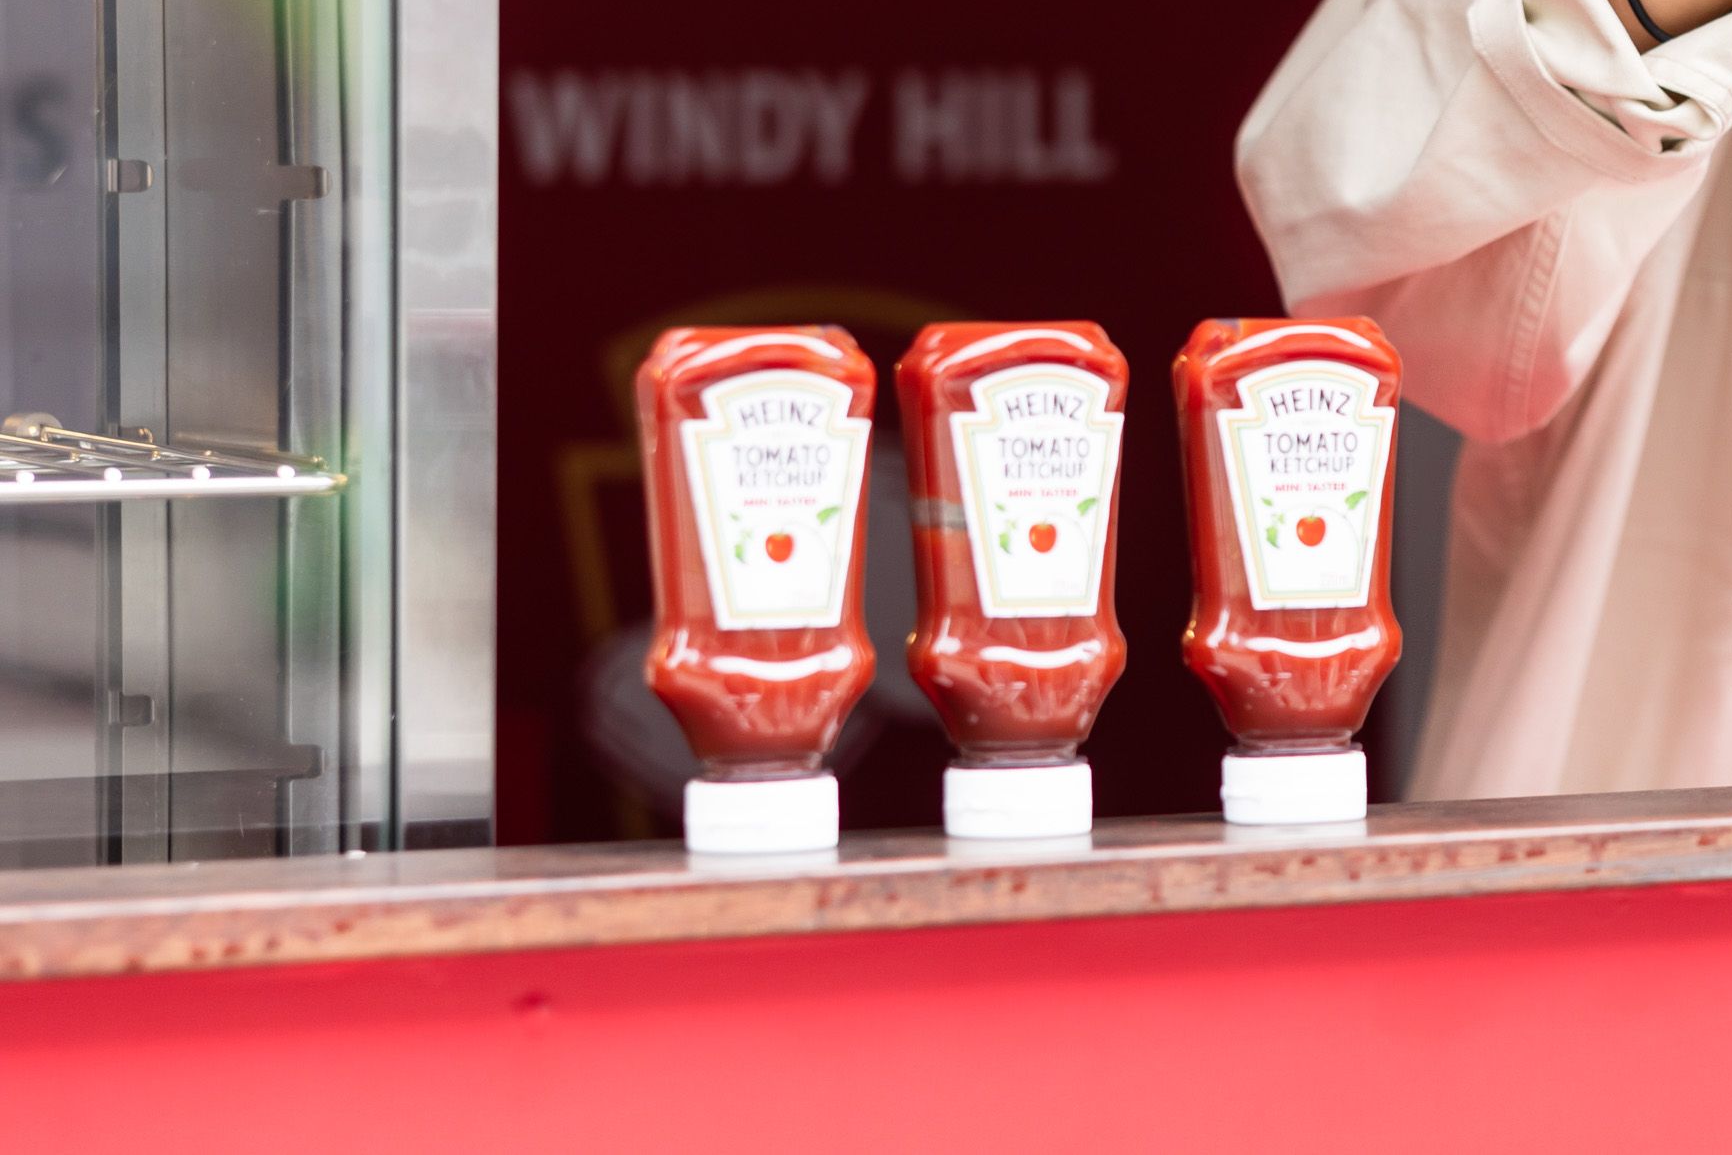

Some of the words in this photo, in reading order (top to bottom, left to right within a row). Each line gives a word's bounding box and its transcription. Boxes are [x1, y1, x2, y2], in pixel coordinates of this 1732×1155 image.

[508, 67, 868, 187] WINDY
[895, 67, 1117, 185] HILL
[739, 399, 825, 428] HEINZ
[1004, 392, 1085, 421] HEINZ
[1269, 388, 1352, 417] HEINZ
[732, 444, 831, 467] TOMATO
[998, 436, 1090, 459] TOMATO
[1264, 431, 1358, 455] TOMATO
[1270, 456, 1356, 474] KETCHUP
